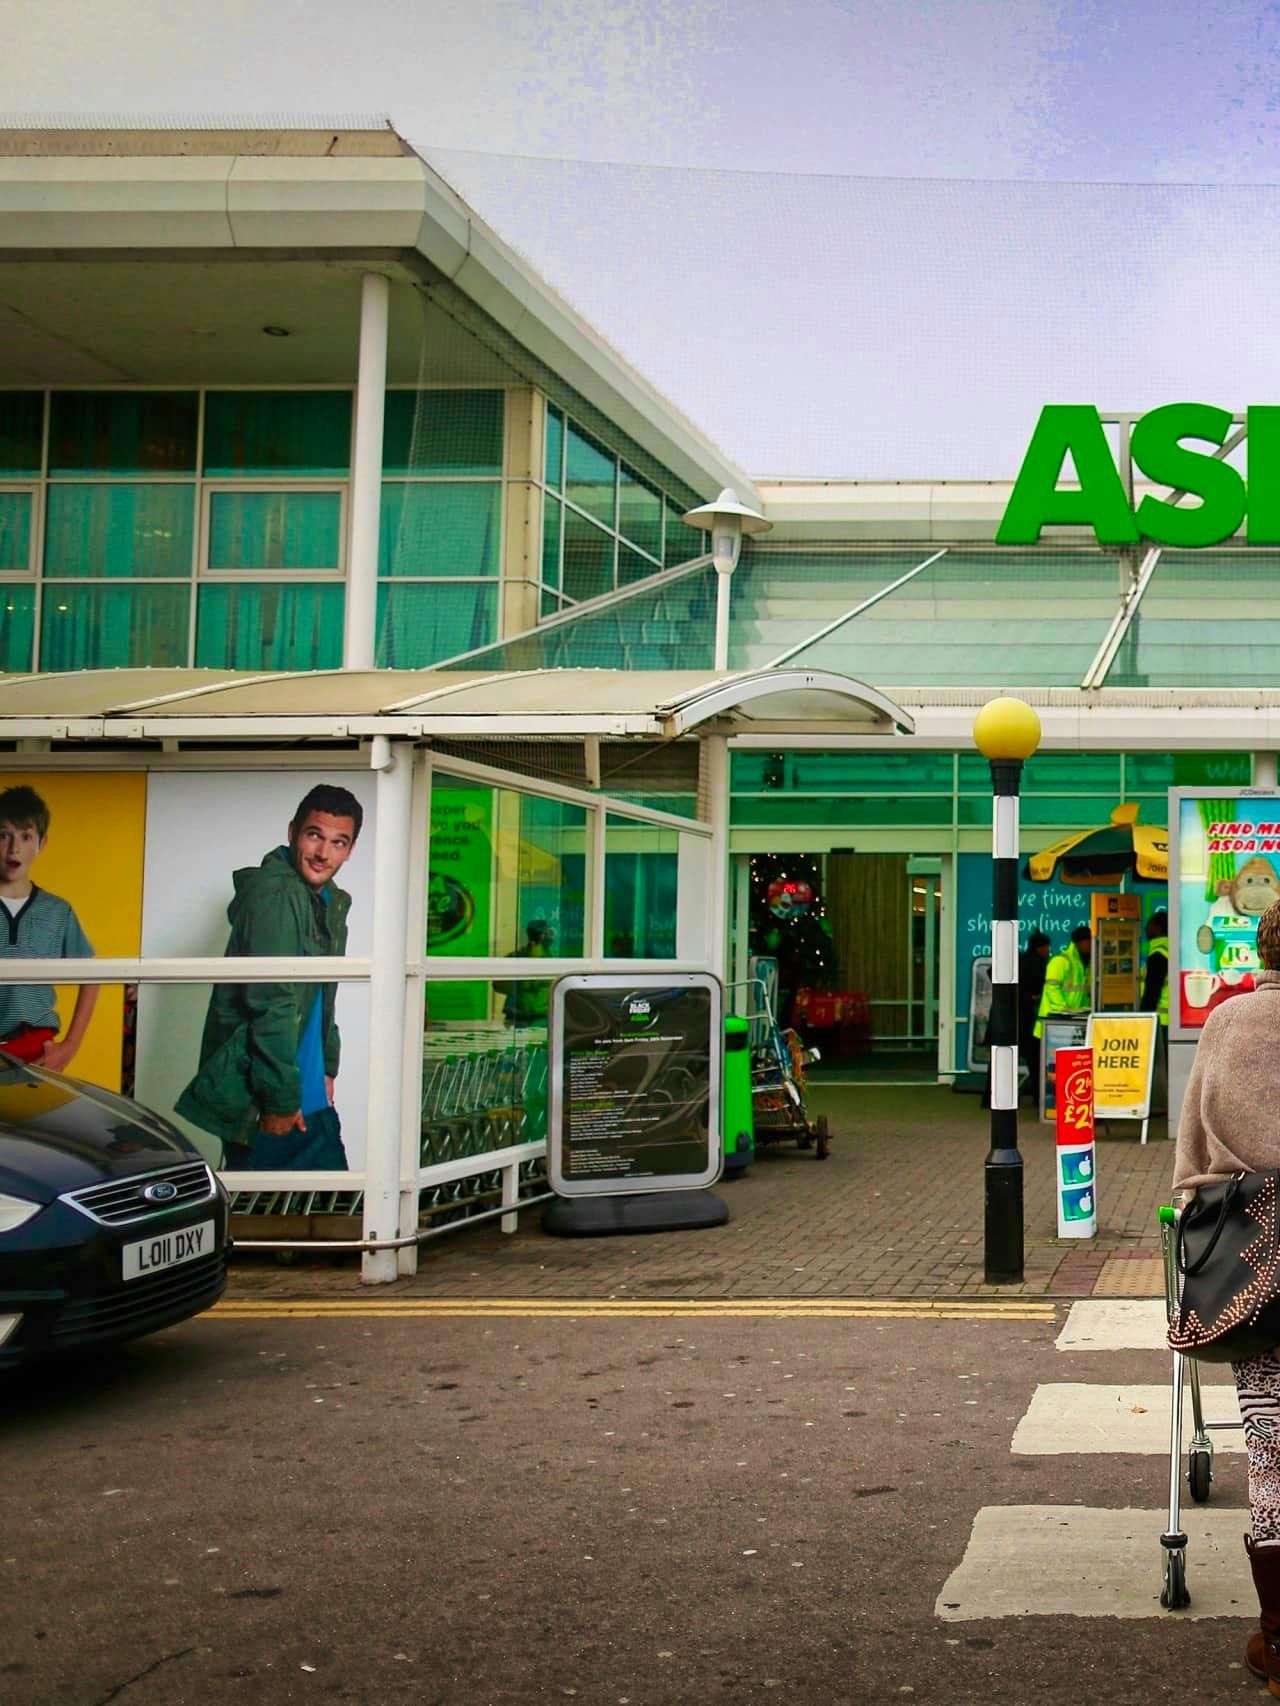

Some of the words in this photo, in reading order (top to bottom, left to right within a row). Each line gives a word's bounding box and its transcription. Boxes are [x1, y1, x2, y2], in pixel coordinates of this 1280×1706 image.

[1208, 822, 1255, 837] FIND
[1208, 839, 1258, 854] ASDA
[1042, 888, 1086, 909] time,
[1101, 1038, 1139, 1051] JOIN
[1098, 1056, 1140, 1069] HERE
[1064, 1104, 1093, 1130] £2
[176, 1227, 203, 1259] DXY
